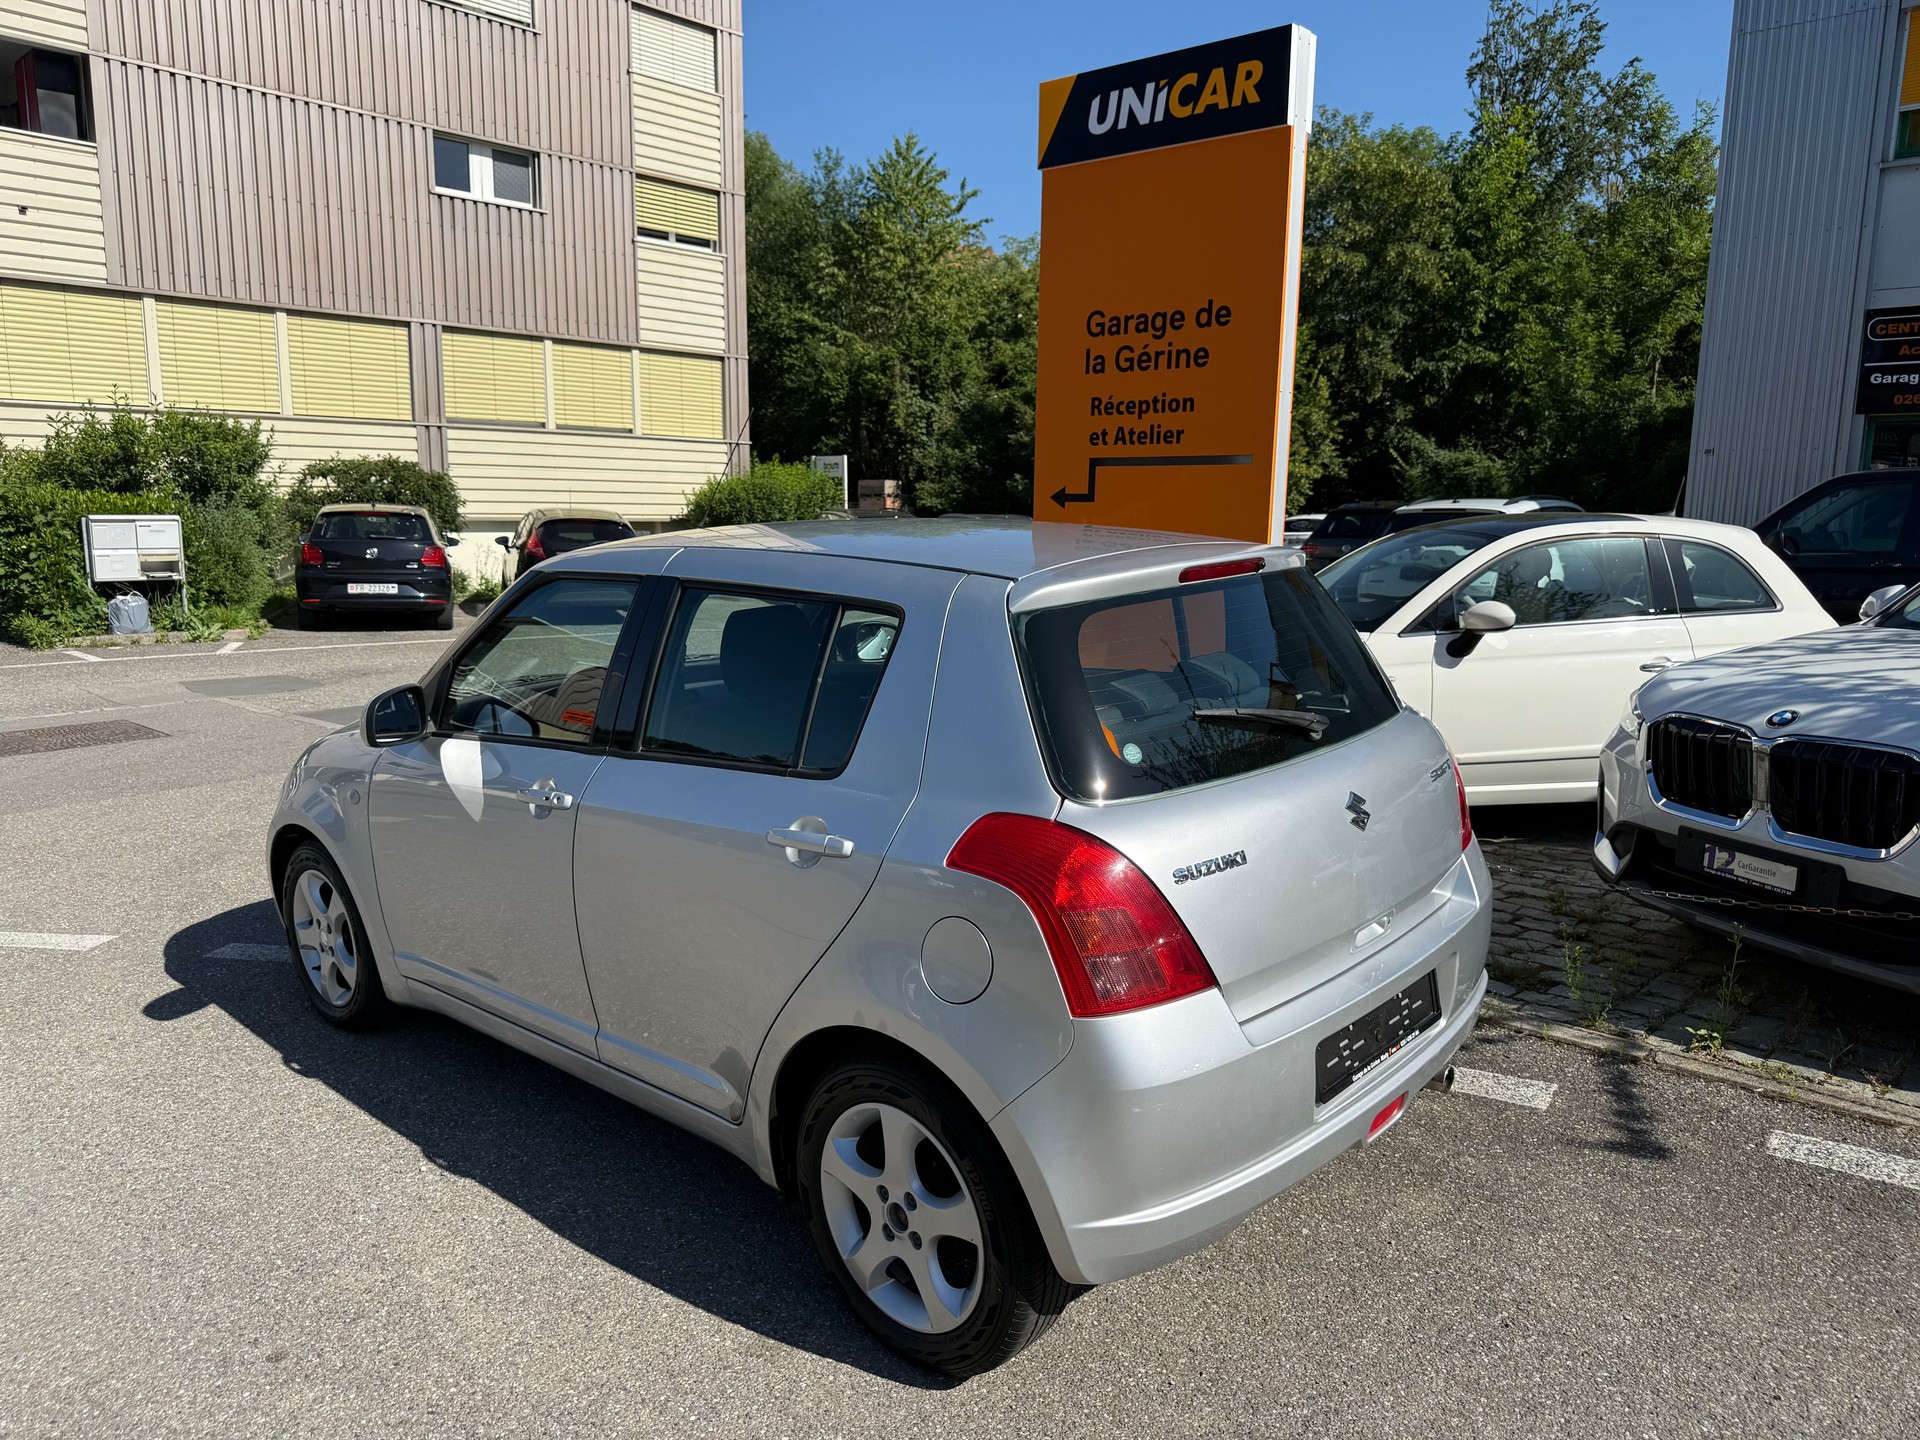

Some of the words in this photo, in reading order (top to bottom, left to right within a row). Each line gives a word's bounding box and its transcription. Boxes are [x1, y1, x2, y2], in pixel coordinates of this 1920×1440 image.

[1086, 309, 1186, 339] Garage
[1195, 299, 1232, 329] de
[1085, 348, 1106, 375] la
[1114, 342, 1210, 373] Gérine
[1870, 373, 1920, 385] Garag
[1090, 392, 1196, 420] Réception
[1089, 428, 1109, 447] et
[1113, 424, 1185, 446] Atelier
[1172, 849, 1248, 885] SUZUKI
[1737, 859, 1777, 878] CarGarantie
